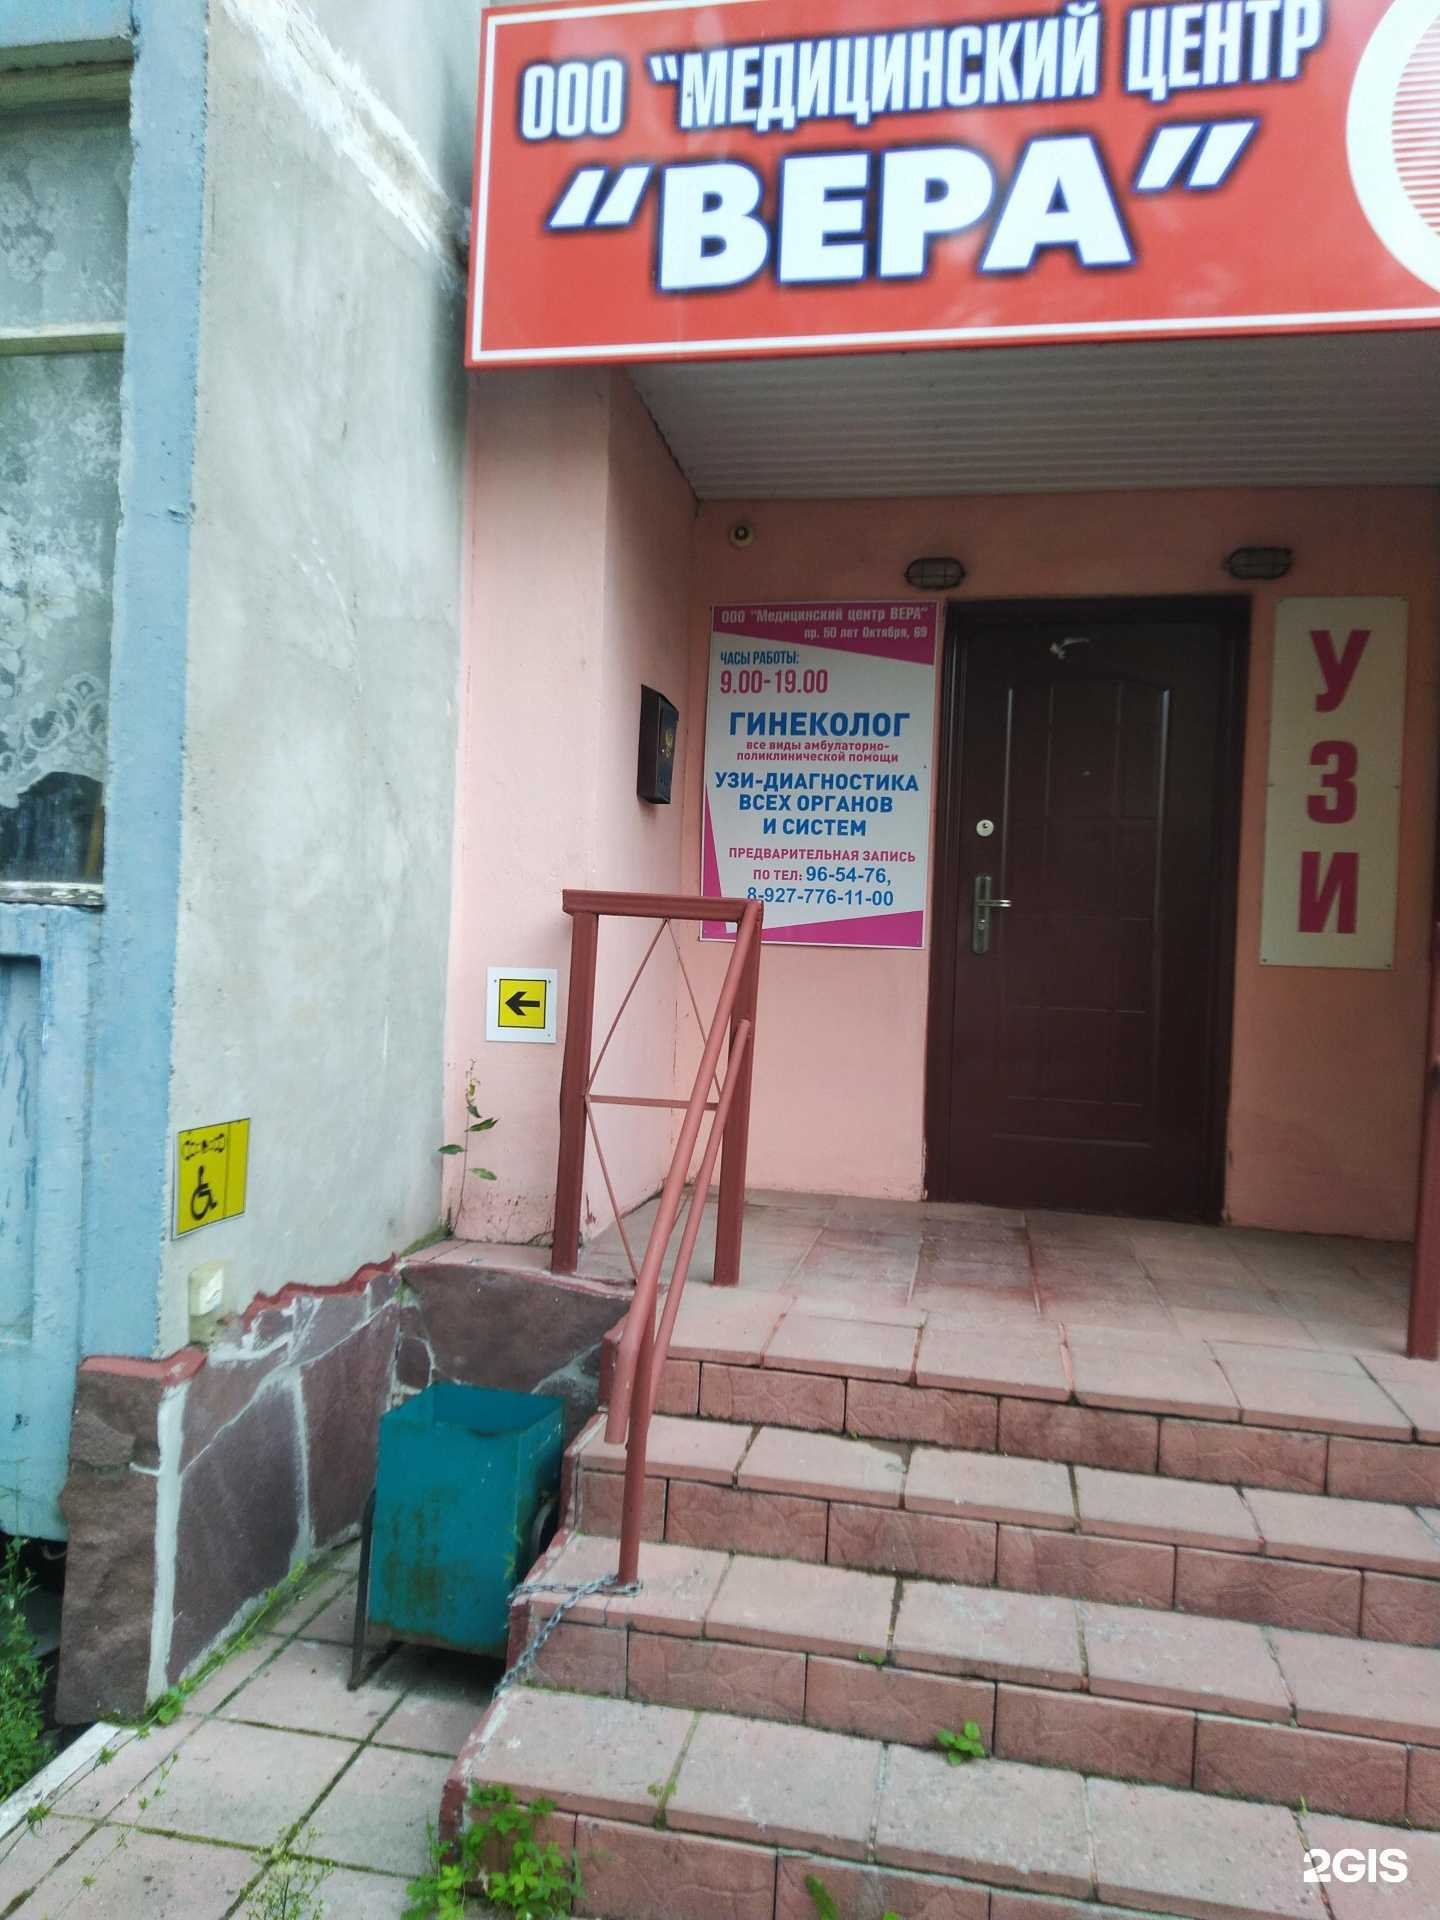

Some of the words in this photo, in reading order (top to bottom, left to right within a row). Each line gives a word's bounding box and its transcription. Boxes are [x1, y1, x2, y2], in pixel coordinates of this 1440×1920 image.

[520, 59, 625, 140] ООО
[650, 2, 1098, 131] "МЕДИЦИНСКИЙ
[1126, 0, 1322, 102] ЦЕНТР
[549, 121, 1256, 291] "ВЕРА"
[721, 610, 746, 623] ООО
[848, 609, 886, 623] центр
[804, 628, 820, 640] пр.
[823, 627, 837, 638] 50
[840, 628, 858, 639] лет
[720, 651, 750, 665] ЧАСЫ
[753, 651, 800, 665] РАБОТЫ:
[720, 669, 828, 694] 9.00-19.00
[729, 712, 911, 737] ГИНЕКОЛОГ
[746, 741, 768, 750] все
[772, 741, 801, 752] виды
[804, 740, 889, 753] амбулаторно-
[737, 752, 845, 763] поликлинической
[848, 753, 898, 763] помощи
[715, 772, 919, 792] УЗИ-ДИАГНОСТИКА
[1297, 630, 1372, 934] УЗИ
[739, 794, 791, 811] ВСЕХ
[797, 796, 893, 813] ОРГАНОВ
[763, 818, 776, 834] И
[783, 819, 866, 836] СИСТЕМ
[729, 847, 859, 861] ПРЕДВАРИТЕЛЬНАЯ
[863, 850, 916, 863] ЗАПИСЬ
[753, 869, 770, 880] ПО
[773, 869, 803, 881] ТЕЛ:
[806, 866, 892, 886] 96-54-76,
[747, 887, 894, 906] 8-927-776-11-00
